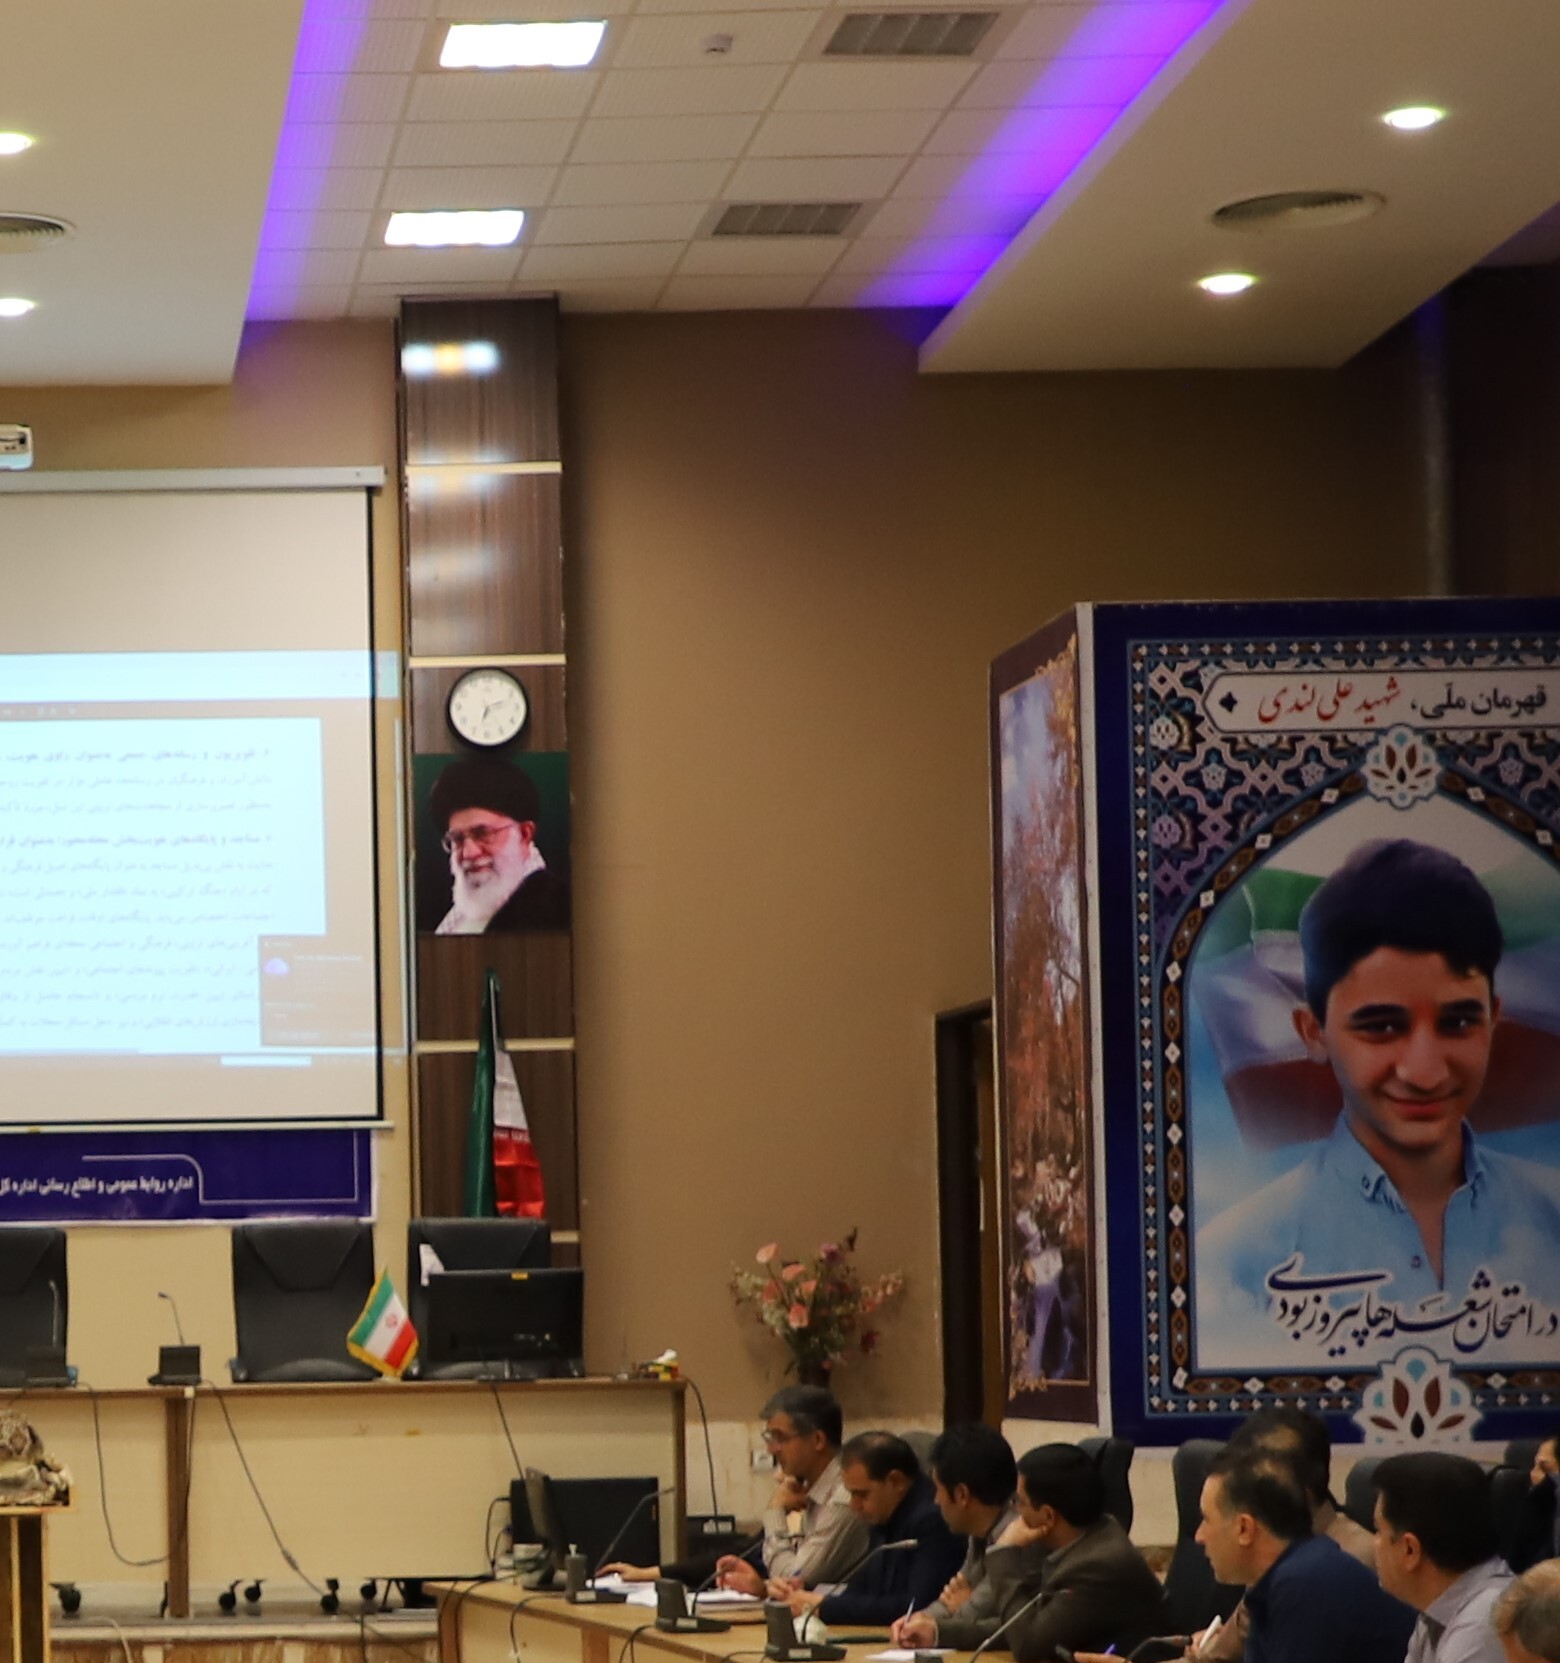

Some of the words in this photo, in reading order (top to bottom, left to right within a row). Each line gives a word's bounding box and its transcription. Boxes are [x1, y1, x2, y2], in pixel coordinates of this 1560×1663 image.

[1257, 682, 1317, 724] لندی
[1316, 677, 1354, 722] علی
[1354, 675, 1401, 724] شهید
[1470, 684, 1548, 718] قهرمان
[11, 1177, 38, 1196] اداره
[38, 1176, 70, 1196] رسانی
[97, 1178, 105, 1195] و
[105, 1177, 138, 1196] عمومی
[138, 1175, 167, 1195] روابط
[167, 1175, 195, 1195] اداره
[1266, 1255, 1388, 1341] بودی
[1304, 1293, 1370, 1357] پیروز
[1451, 1284, 1535, 1352] امتحان
[1533, 1311, 1560, 1337] در
